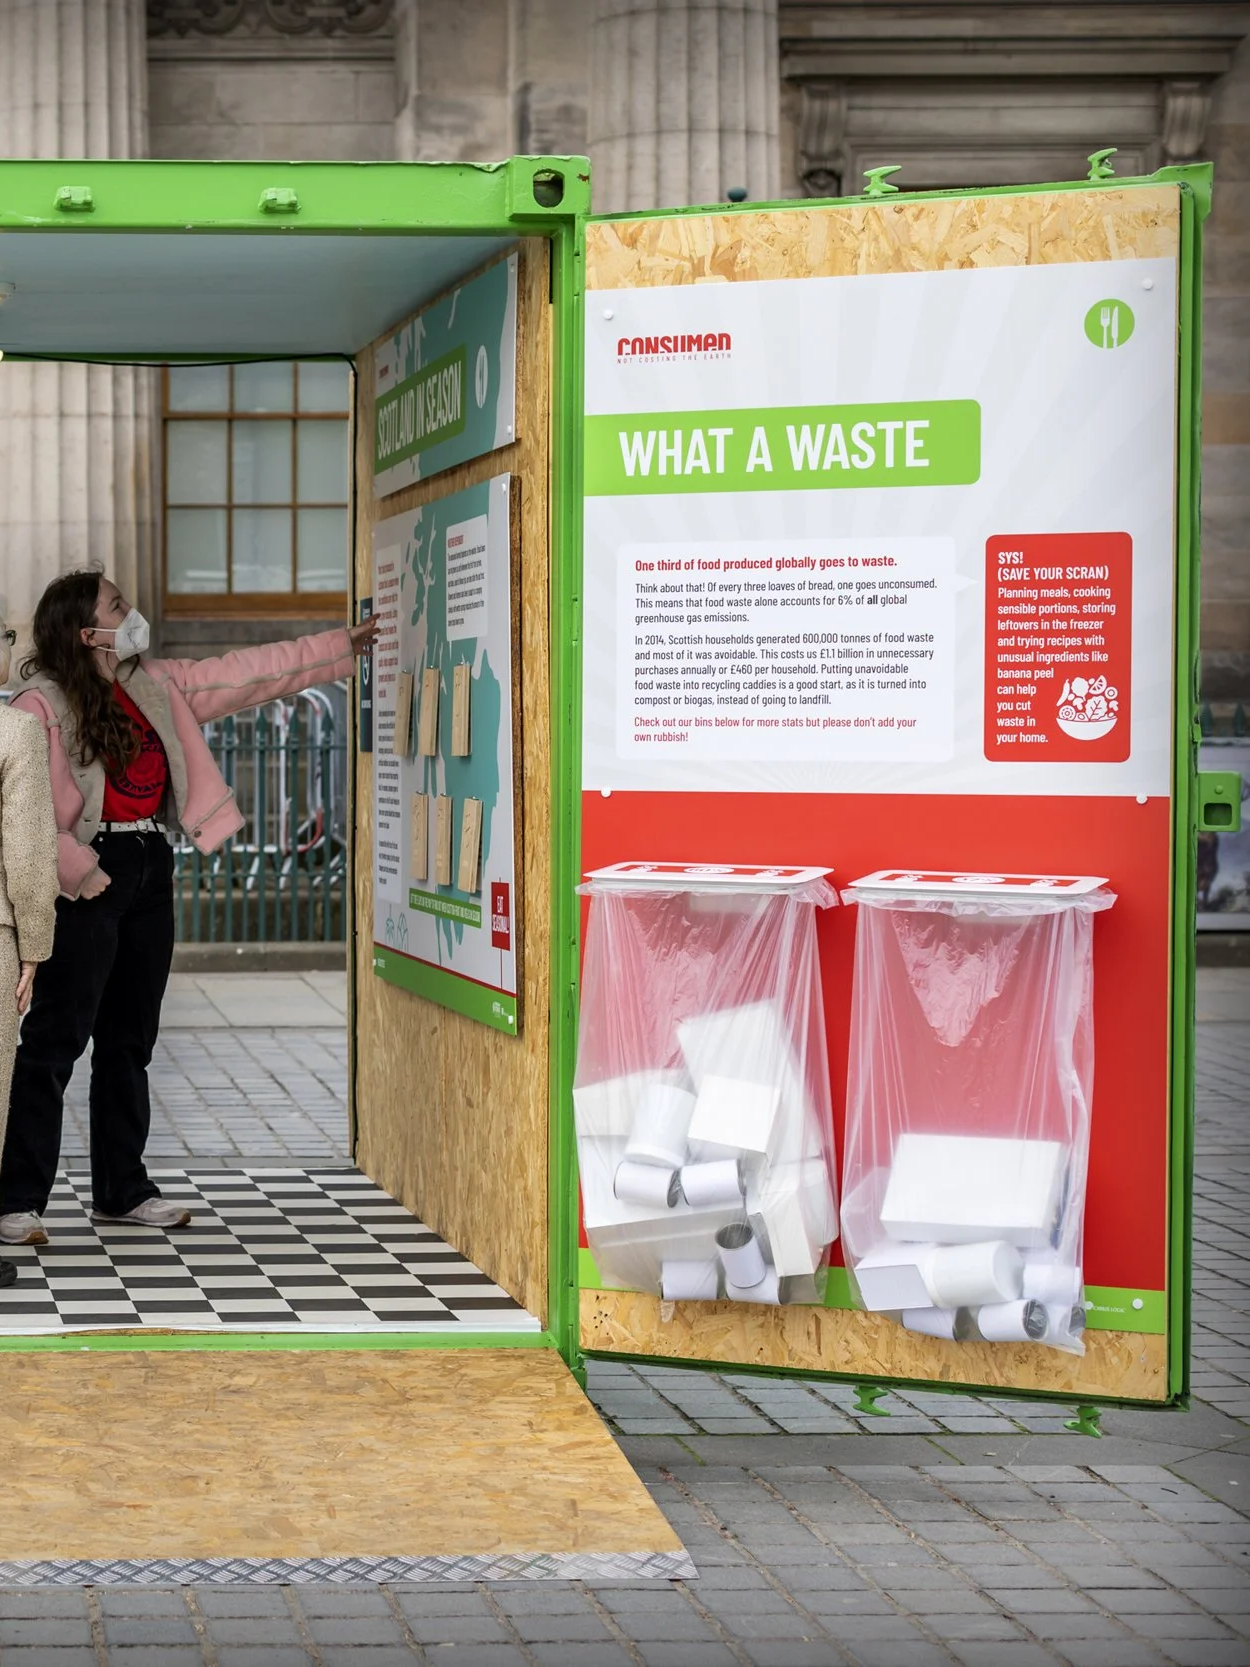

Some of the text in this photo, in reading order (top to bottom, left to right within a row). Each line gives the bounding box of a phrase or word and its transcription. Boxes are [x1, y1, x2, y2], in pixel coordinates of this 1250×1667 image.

[639, 355, 676, 363] COSTING
[682, 353, 697, 361] THE
[704, 352, 731, 360] EARTH
[378, 361, 461, 460] SCOTLAND IN SEASON
[618, 420, 930, 477] WHAT A WASTE
[635, 556, 897, 572] One third of food produced globally goes to waste.
[998, 551, 1023, 564] SYS!
[997, 566, 1109, 582] (SAVE YOUR SCRAN)
[635, 578, 937, 594] Think about that! Of every three loaves of bread, one goes unconsumed.
[998, 586, 1111, 600] Planning meals, cooking
[997, 602, 1116, 616] sensible portions, storing
[634, 612, 750, 626] greenhouse gas emissions.
[997, 619, 1104, 630] leftovers in the freezer
[997, 634, 1105, 649] and trying recipes with
[997, 650, 1109, 664] unusual ingredients like
[997, 667, 1054, 680] banana peel
[996, 683, 1037, 696] can help
[996, 700, 1031, 713] you cut
[996, 715, 1036, 727] waste in
[996, 732, 1048, 745] your home.
